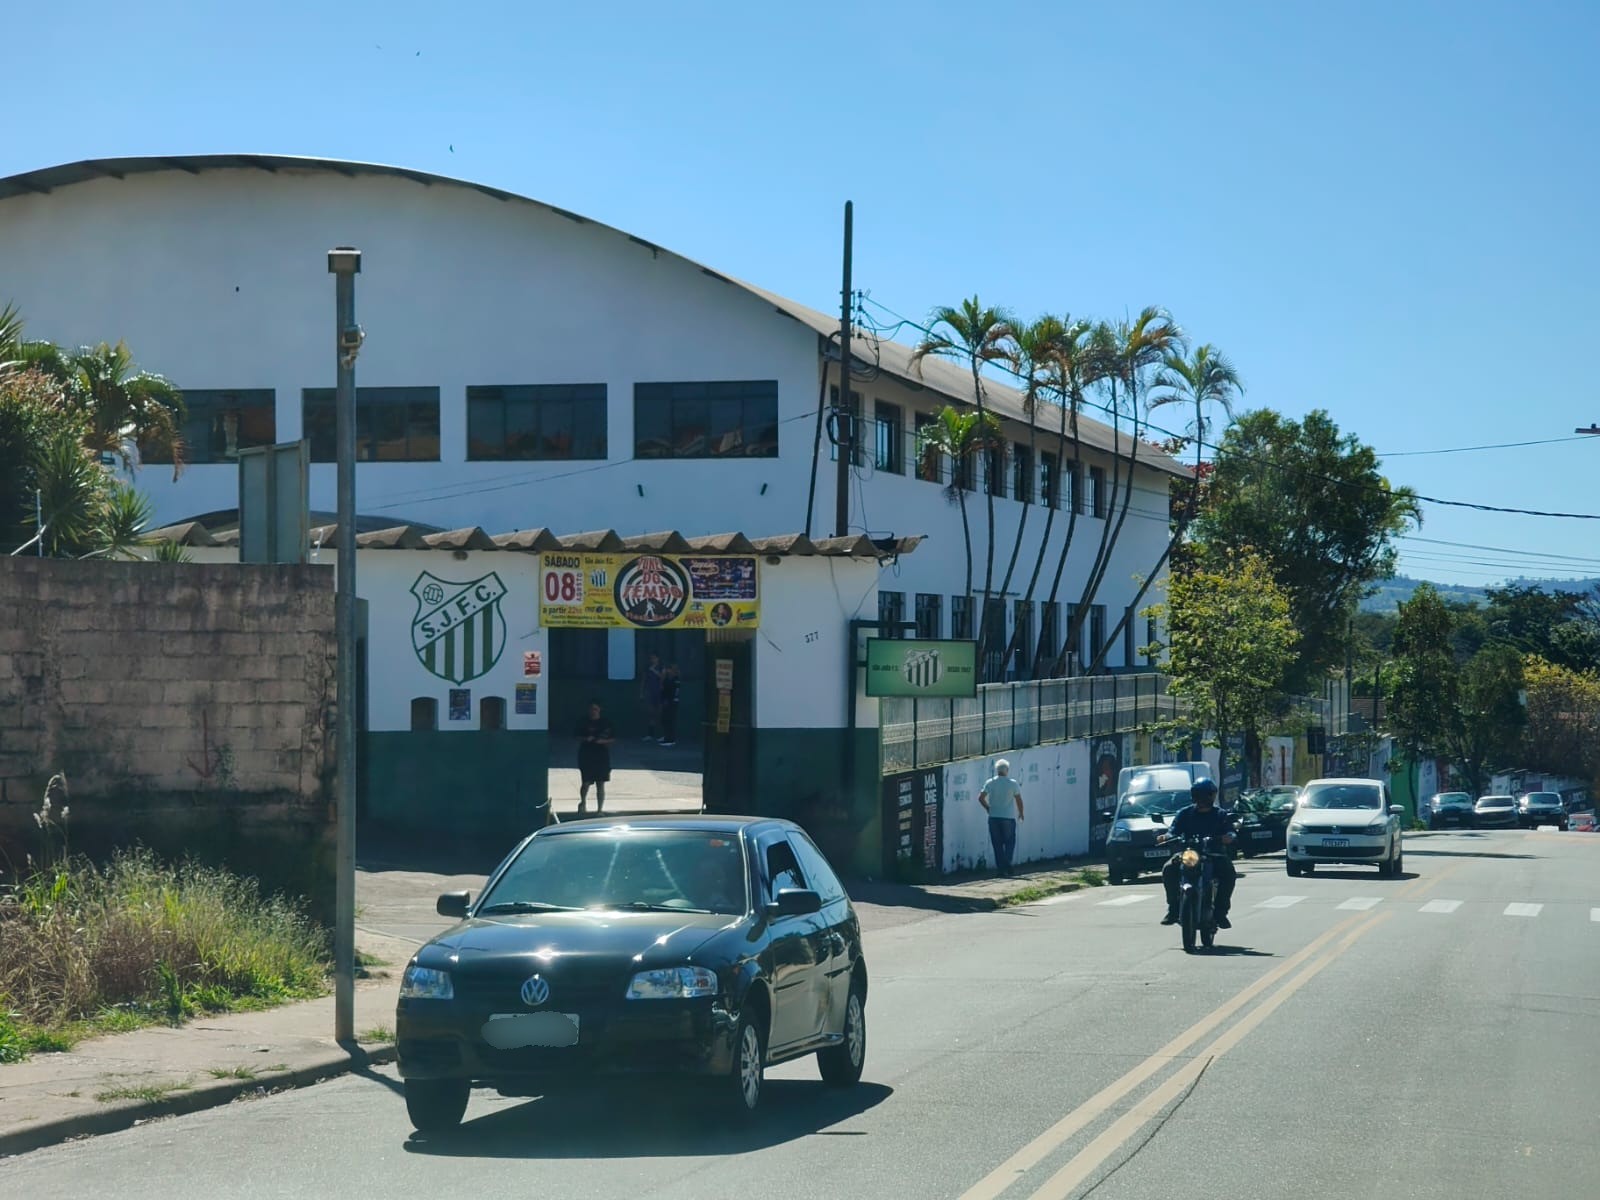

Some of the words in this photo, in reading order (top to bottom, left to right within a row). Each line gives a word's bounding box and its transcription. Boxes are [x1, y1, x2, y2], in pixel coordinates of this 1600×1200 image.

[545, 571, 576, 601] 08
[623, 584, 684, 600] TEMPO
[548, 606, 567, 615] partir
